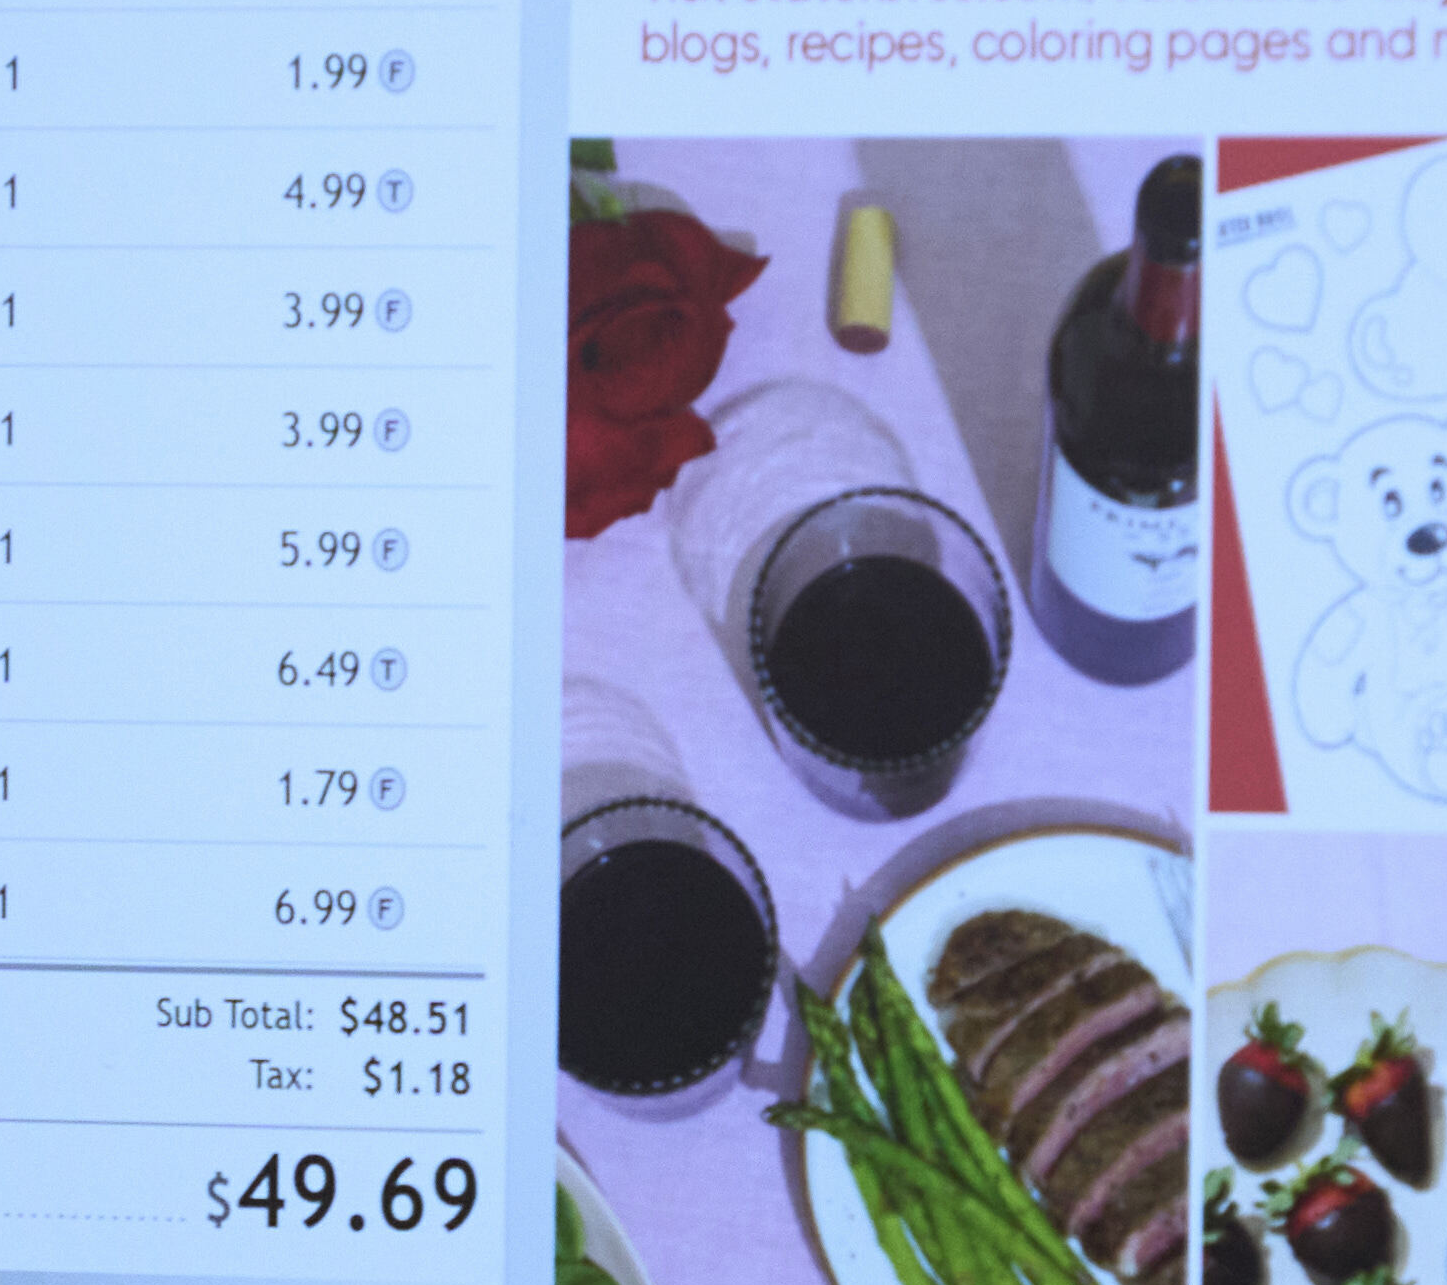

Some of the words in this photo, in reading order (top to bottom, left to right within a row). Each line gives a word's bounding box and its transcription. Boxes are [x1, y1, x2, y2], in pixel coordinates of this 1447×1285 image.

[641, 22, 769, 74] blogs,
[788, 31, 956, 71] recipes,
[972, 21, 1152, 74] coloring
[1167, 30, 1310, 72] pages
[1327, 21, 1416, 60] and
[4, 57, 18, 90] 1
[291, 54, 367, 89] 1.99
[2, 176, 17, 208] 1
[284, 173, 366, 208] 4.99
[1, 293, 15, 327] 1
[285, 292, 364, 328] 3.99
[0, 412, 14, 445] 1
[283, 411, 363, 447] 3.99
[281, 531, 361, 567] 5.99
[278, 651, 359, 686] 6.49
[280, 770, 358, 805] 1.79
[275, 889, 356, 925] 6.99
[157, 997, 212, 1028] Sub
[224, 999, 313, 1030] Total:
[341, 996, 466, 1036] $48.51
[250, 1059, 312, 1089] Tax:
[364, 1057, 470, 1096] $1.18
[209, 1153, 477, 1231] $49.69
